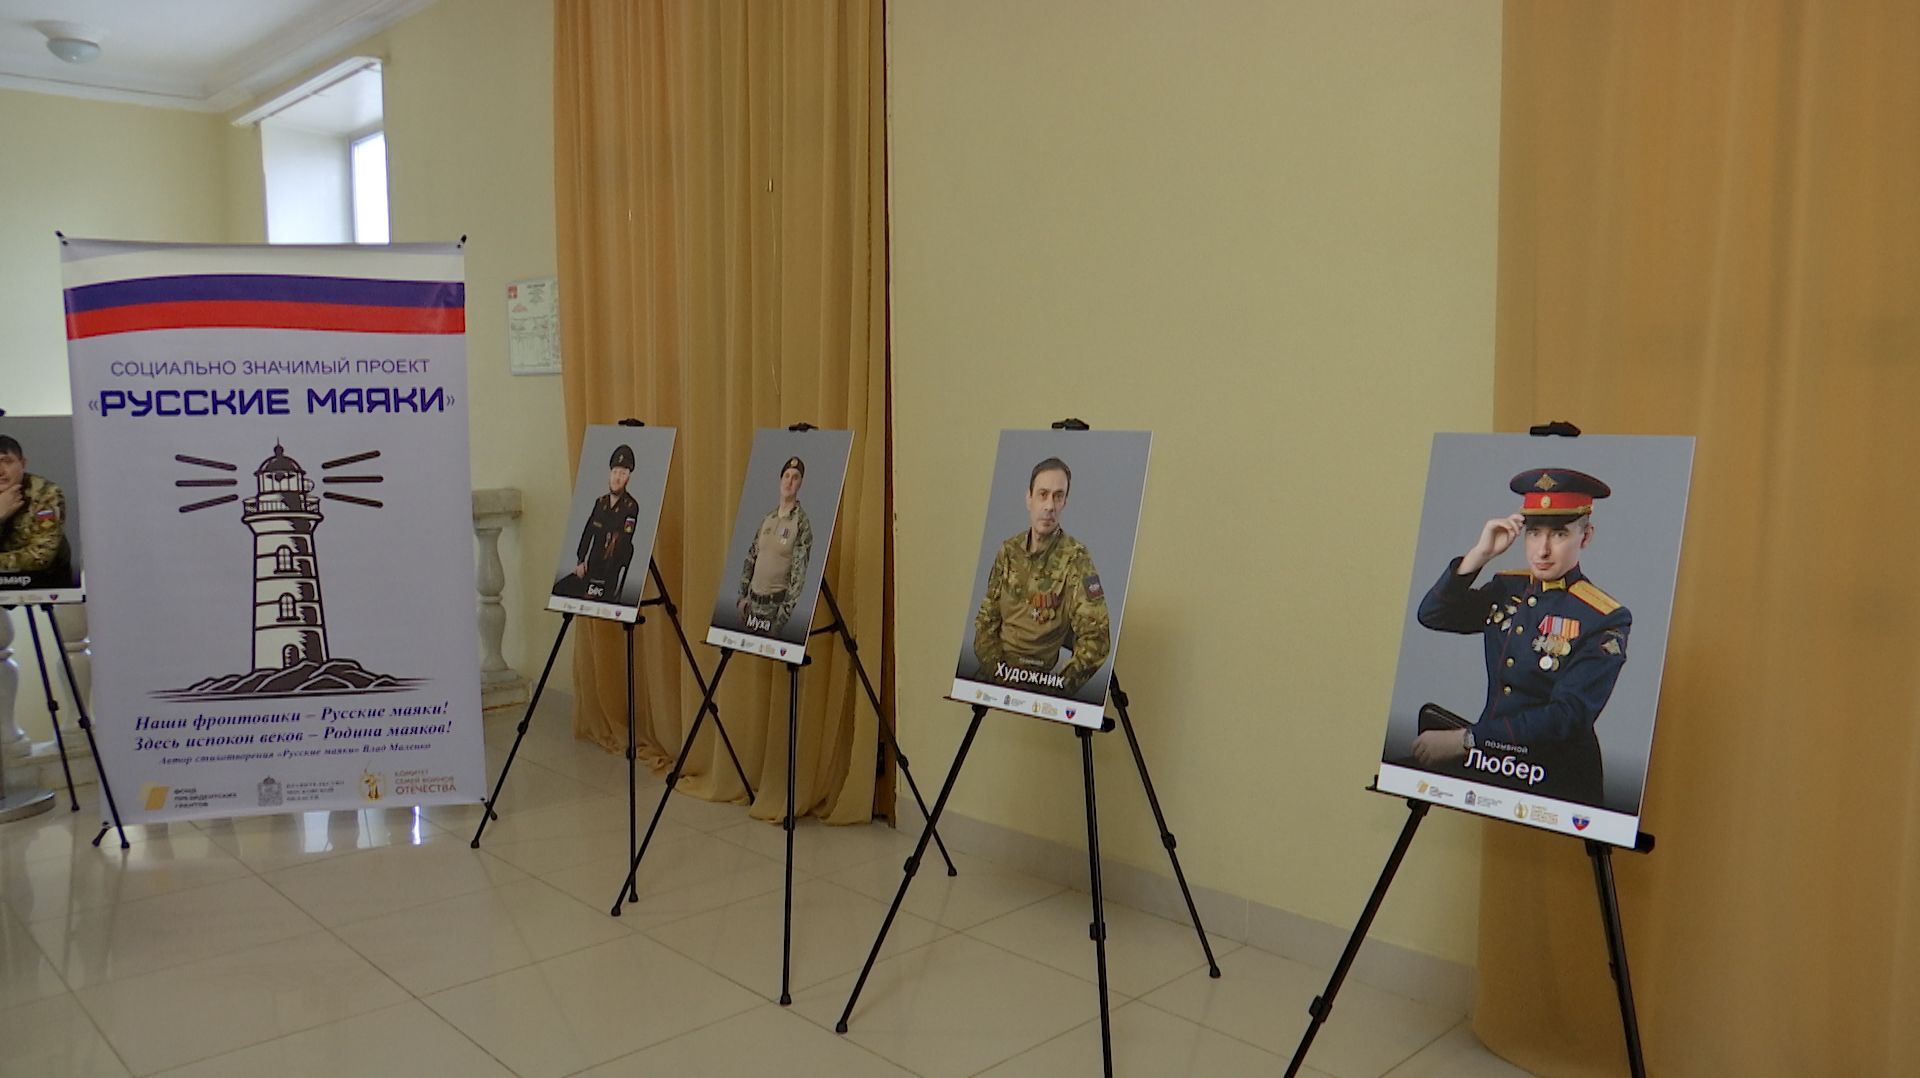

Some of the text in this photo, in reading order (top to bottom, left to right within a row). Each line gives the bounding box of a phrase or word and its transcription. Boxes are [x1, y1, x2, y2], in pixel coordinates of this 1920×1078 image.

[111, 356, 430, 378] СОЦИАЛЬНО ЗНАЧИМЫЙ ПРОЕКТ
[88, 387, 455, 417] «РУССКИЕ МАЯКИ»
[746, 614, 771, 631] Муха
[995, 662, 1065, 689] Художник
[135, 716, 187, 731] Наши
[192, 711, 301, 731] фронтовики
[321, 705, 387, 722] Русские
[390, 700, 449, 717] маяки!
[134, 736, 180, 751] Здесь
[186, 733, 254, 748] испокон
[259, 731, 304, 744] веков
[323, 726, 383, 741] Родина
[386, 720, 453, 737] маяков!
[1464, 747, 1547, 785] Любер
[395, 783, 457, 795] ОТЕЧЕСТВА
